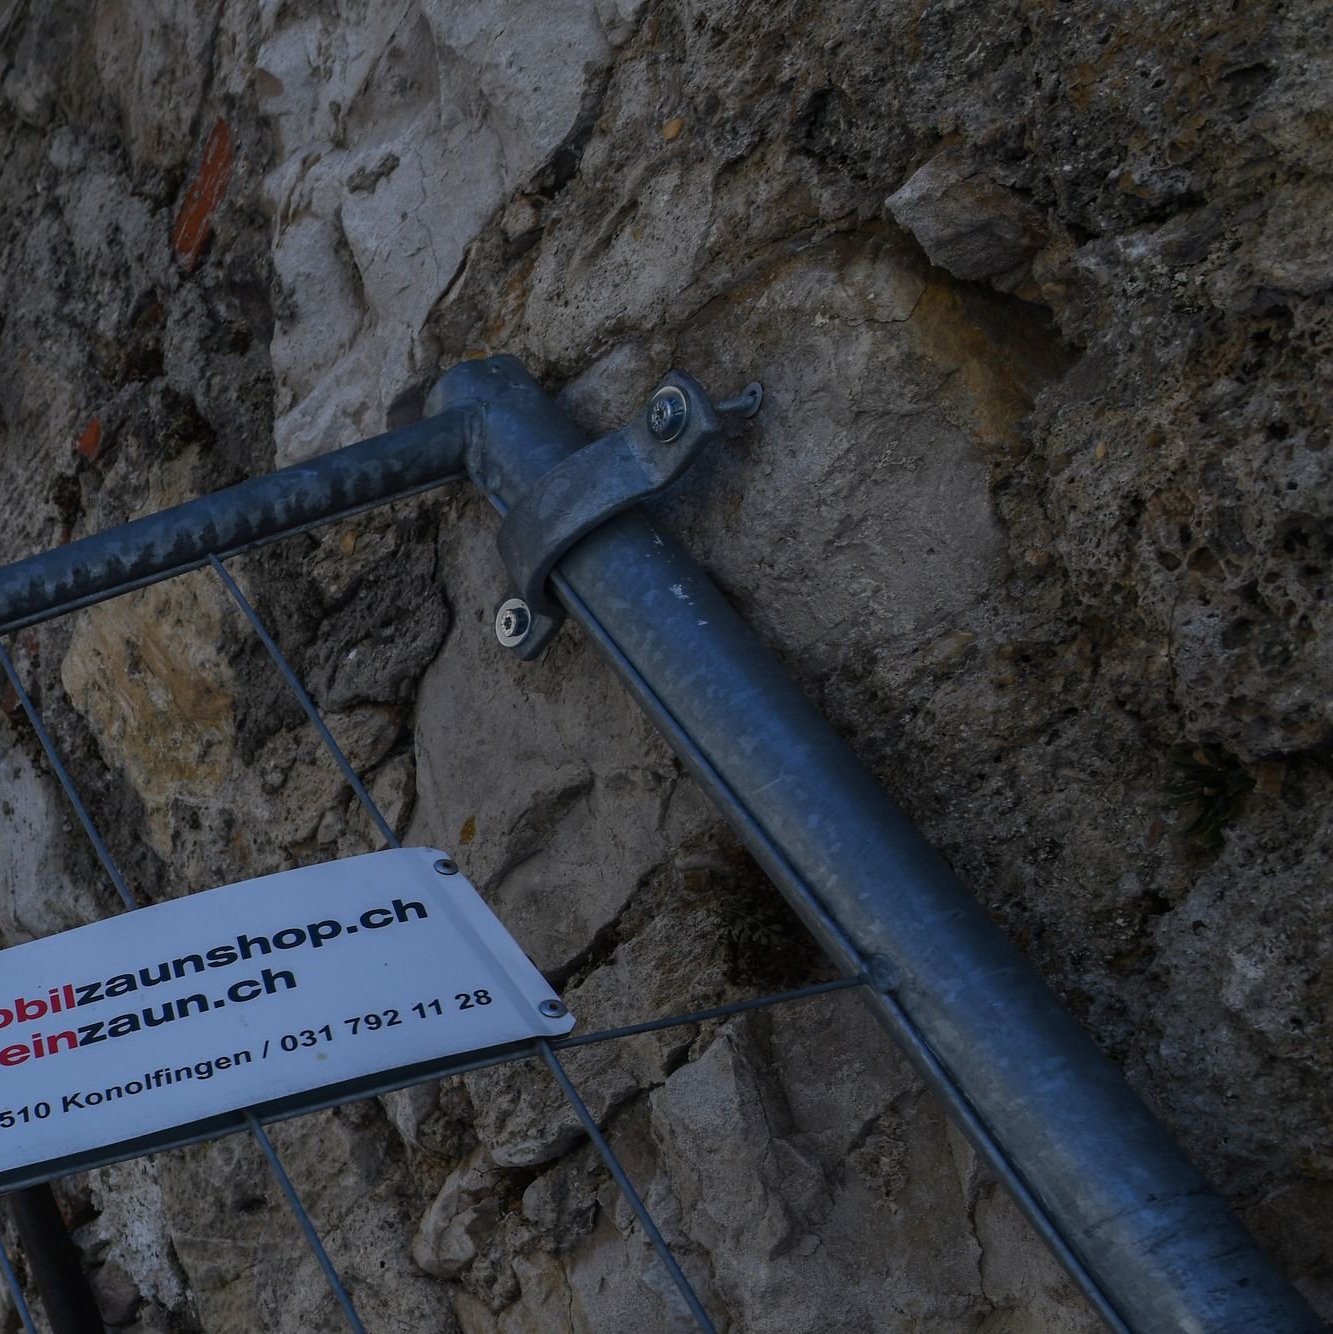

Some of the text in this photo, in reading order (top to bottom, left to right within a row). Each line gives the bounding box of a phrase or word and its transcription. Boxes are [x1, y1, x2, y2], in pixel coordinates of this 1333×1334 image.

[61, 1049, 253, 1114] Konolfingen
[261, 1039, 271, 1060] /
[279, 1023, 334, 1053] 031
[342, 1008, 405, 1036] 792
[410, 998, 446, 1020] 11
[453, 988, 493, 1011] 28
